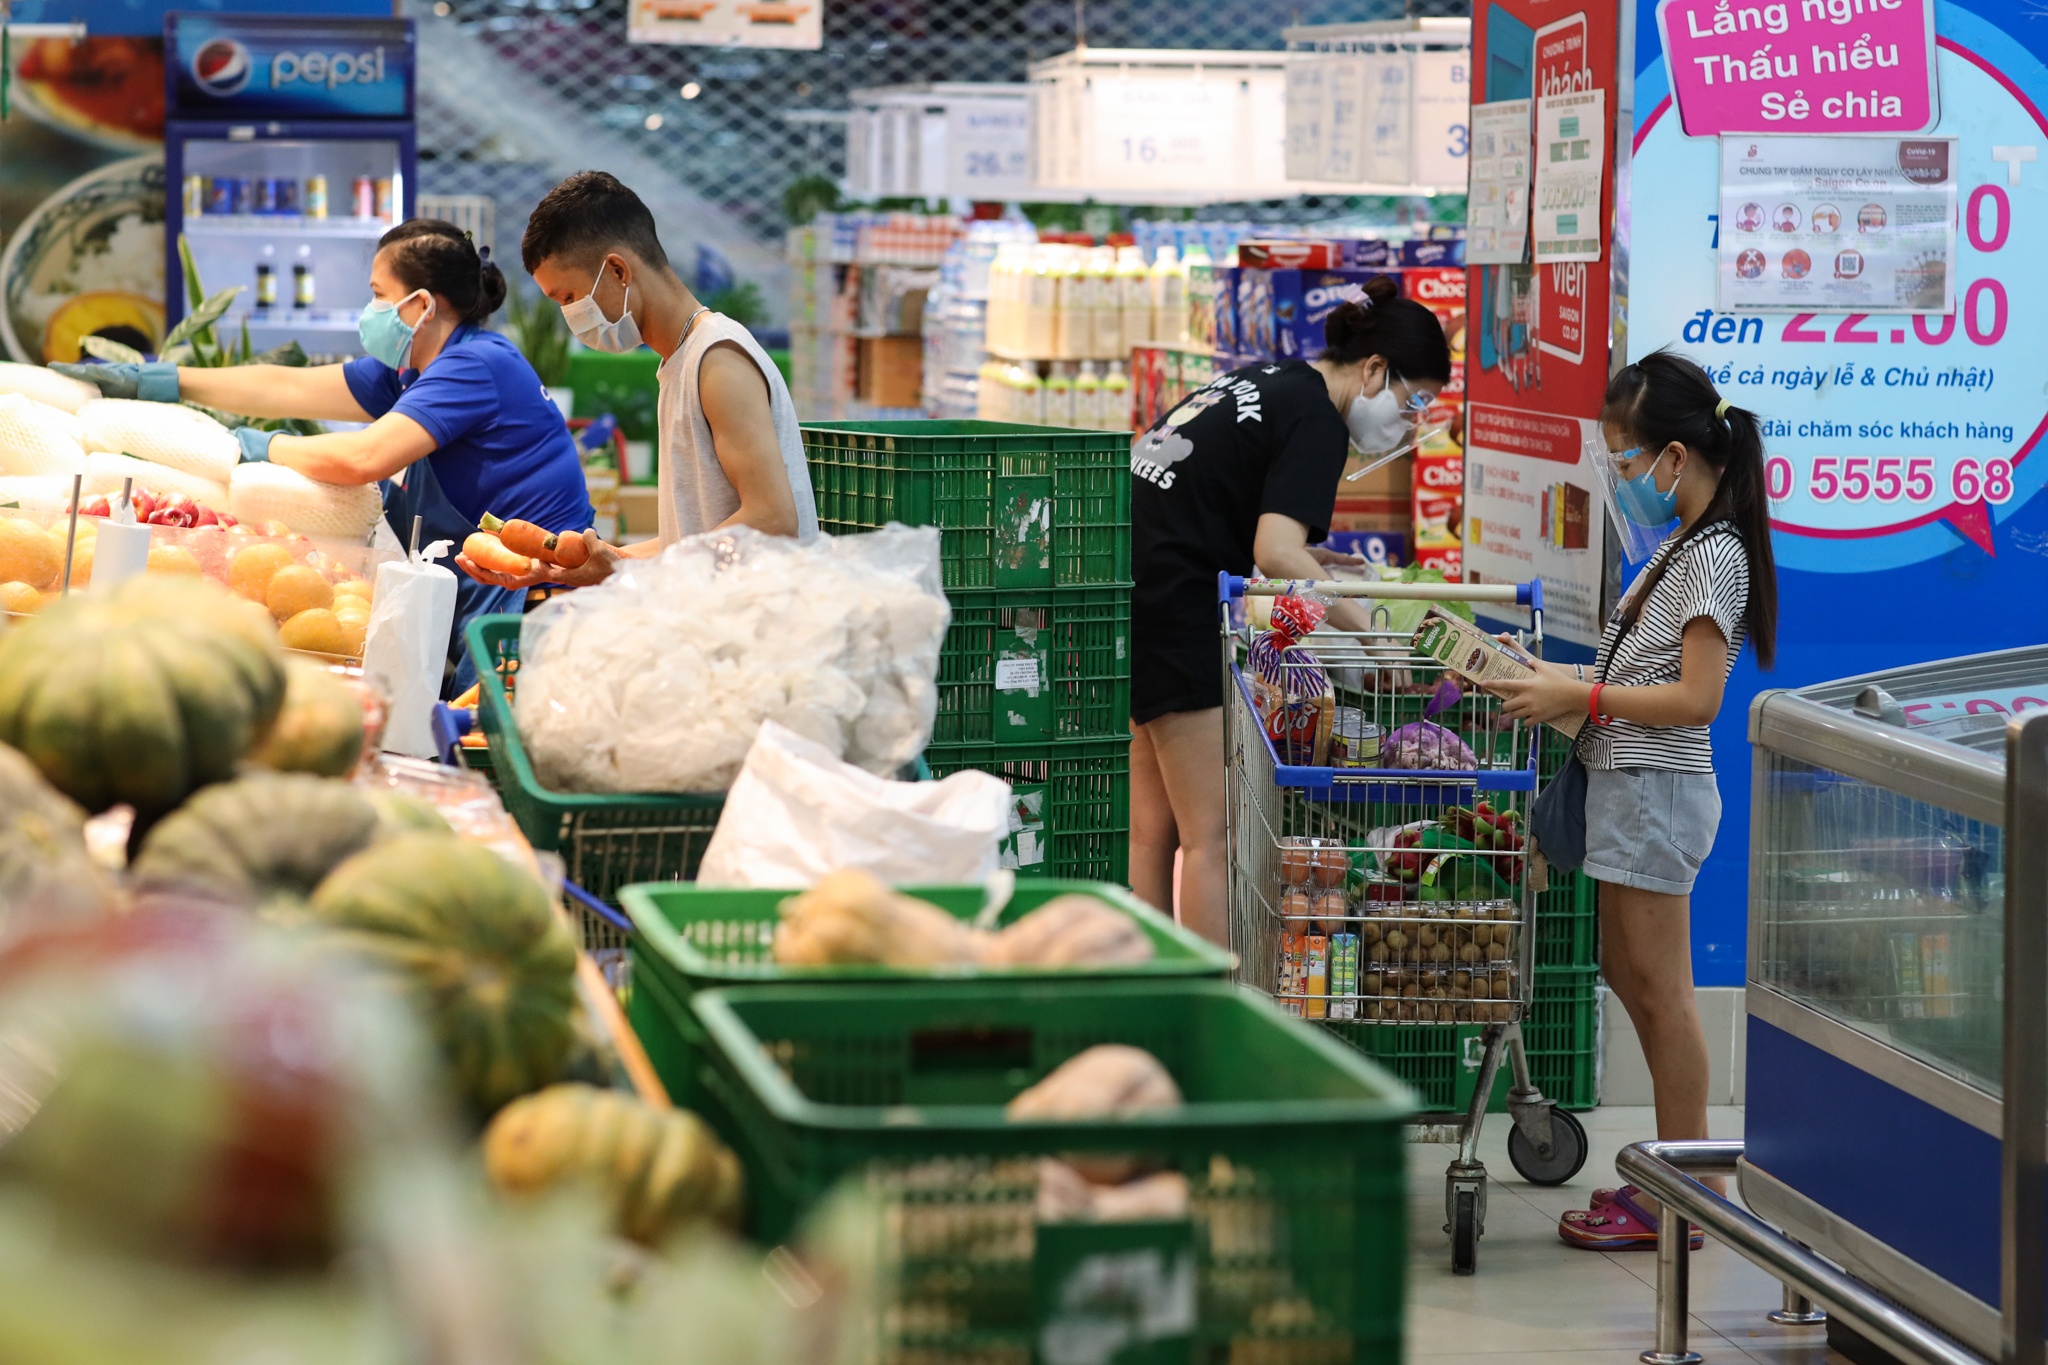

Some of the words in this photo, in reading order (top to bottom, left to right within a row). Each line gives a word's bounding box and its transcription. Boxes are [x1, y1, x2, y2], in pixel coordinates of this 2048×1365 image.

[271, 46, 385, 90] pepsi
[1693, 44, 1798, 85] Thấu
[1812, 33, 1898, 74] hiểu
[1760, 90, 1810, 121] Sẻ
[1822, 90, 1902, 119] chia
[1739, 167, 1772, 176] CHUNG
[1774, 167, 1789, 176] TAY
[1814, 167, 1839, 177] NGUY
[1815, 177, 1852, 189] Saigon
[1559, 305, 1580, 323] SAIGON
[1738, 364, 1764, 385] cả
[1771, 366, 1827, 390] ngày
[1834, 362, 1855, 386] lễ
[1860, 367, 1876, 386] &
[1884, 366, 1929, 387] Chủ
[1936, 366, 1994, 392] nhật)
[1228, 379, 1262, 423] YORK
[1798, 420, 1852, 437] chăm
[1858, 420, 1894, 438] sóc
[1900, 420, 1959, 438] khách
[1966, 420, 2013, 443] hàng
[1809, 457, 1934, 501] 5555
[1951, 457, 2013, 502] 68
